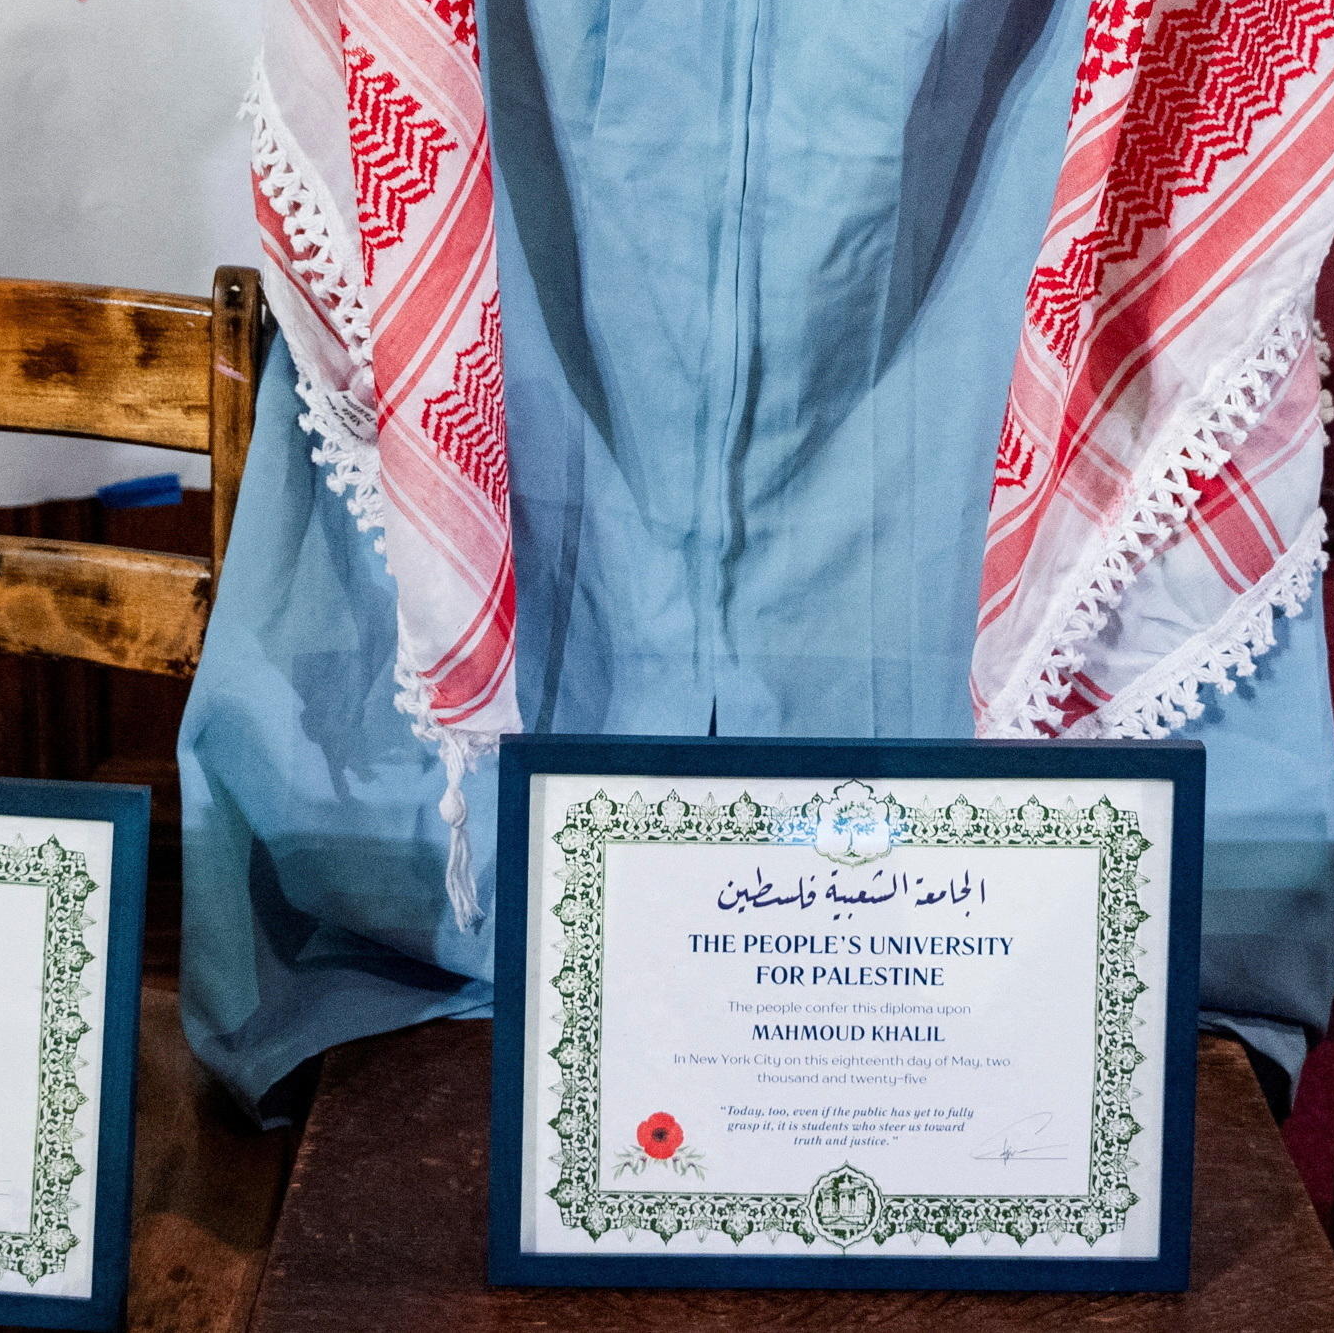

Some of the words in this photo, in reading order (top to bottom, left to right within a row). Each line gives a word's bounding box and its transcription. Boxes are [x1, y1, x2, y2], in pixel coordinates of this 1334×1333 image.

[717, 866, 816, 914] فلسطين
[824, 868, 908, 920] الشعبية
[914, 869, 985, 917] الجامعة
[687, 933, 736, 953] THE
[869, 935, 1013, 956] UNIVERSITY
[756, 965, 805, 986] FOR
[811, 965, 944, 986] PALESTINE
[727, 1000, 753, 1012] The
[755, 1001, 802, 1015] people
[804, 1001, 848, 1013] confer
[852, 1001, 877, 1013] this
[879, 1001, 933, 1016] diploma
[936, 1005, 971, 1016] upon
[751, 1023, 865, 1041] MAHMOUD
[871, 1024, 945, 1042] KHALIL
[673, 1053, 686, 1064] In
[689, 1052, 718, 1064] New
[720, 1053, 750, 1064] York
[753, 1053, 781, 1068] City
[783, 1056, 801, 1065] on
[804, 1054, 828, 1065] this
[831, 1054, 904, 1069] eighteenth
[906, 1055, 931, 1069] day
[934, 1055, 949, 1066] of
[951, 1055, 982, 1069] May,
[985, 1056, 1010, 1066] two
[757, 1071, 818, 1083] thousand
[821, 1072, 846, 1083] and
[850, 1072, 927, 1086] twenty-five
[767, 1106, 789, 1117] too,
[792, 1108, 818, 1116] even
[820, 1105, 832, 1119] if
[832, 1105, 850, 1116] the
[851, 1106, 887, 1119] public
[889, 1106, 911, 1117] has
[913, 1107, 931, 1119] yet
[932, 1107, 945, 1117] to
[944, 1106, 974, 1120] fully
[726, 1122, 760, 1132] grasp
[762, 1120, 774, 1131] it,
[777, 1120, 786, 1131] it
[788, 1120, 798, 1131] is
[800, 1120, 849, 1131] students
[851, 1120, 876, 1132] who
[878, 1121, 906, 1131] steer
[907, 1123, 921, 1132] us
[923, 1121, 965, 1132] toward
[793, 1134, 822, 1145] truth
[824, 1134, 848, 1145] and
